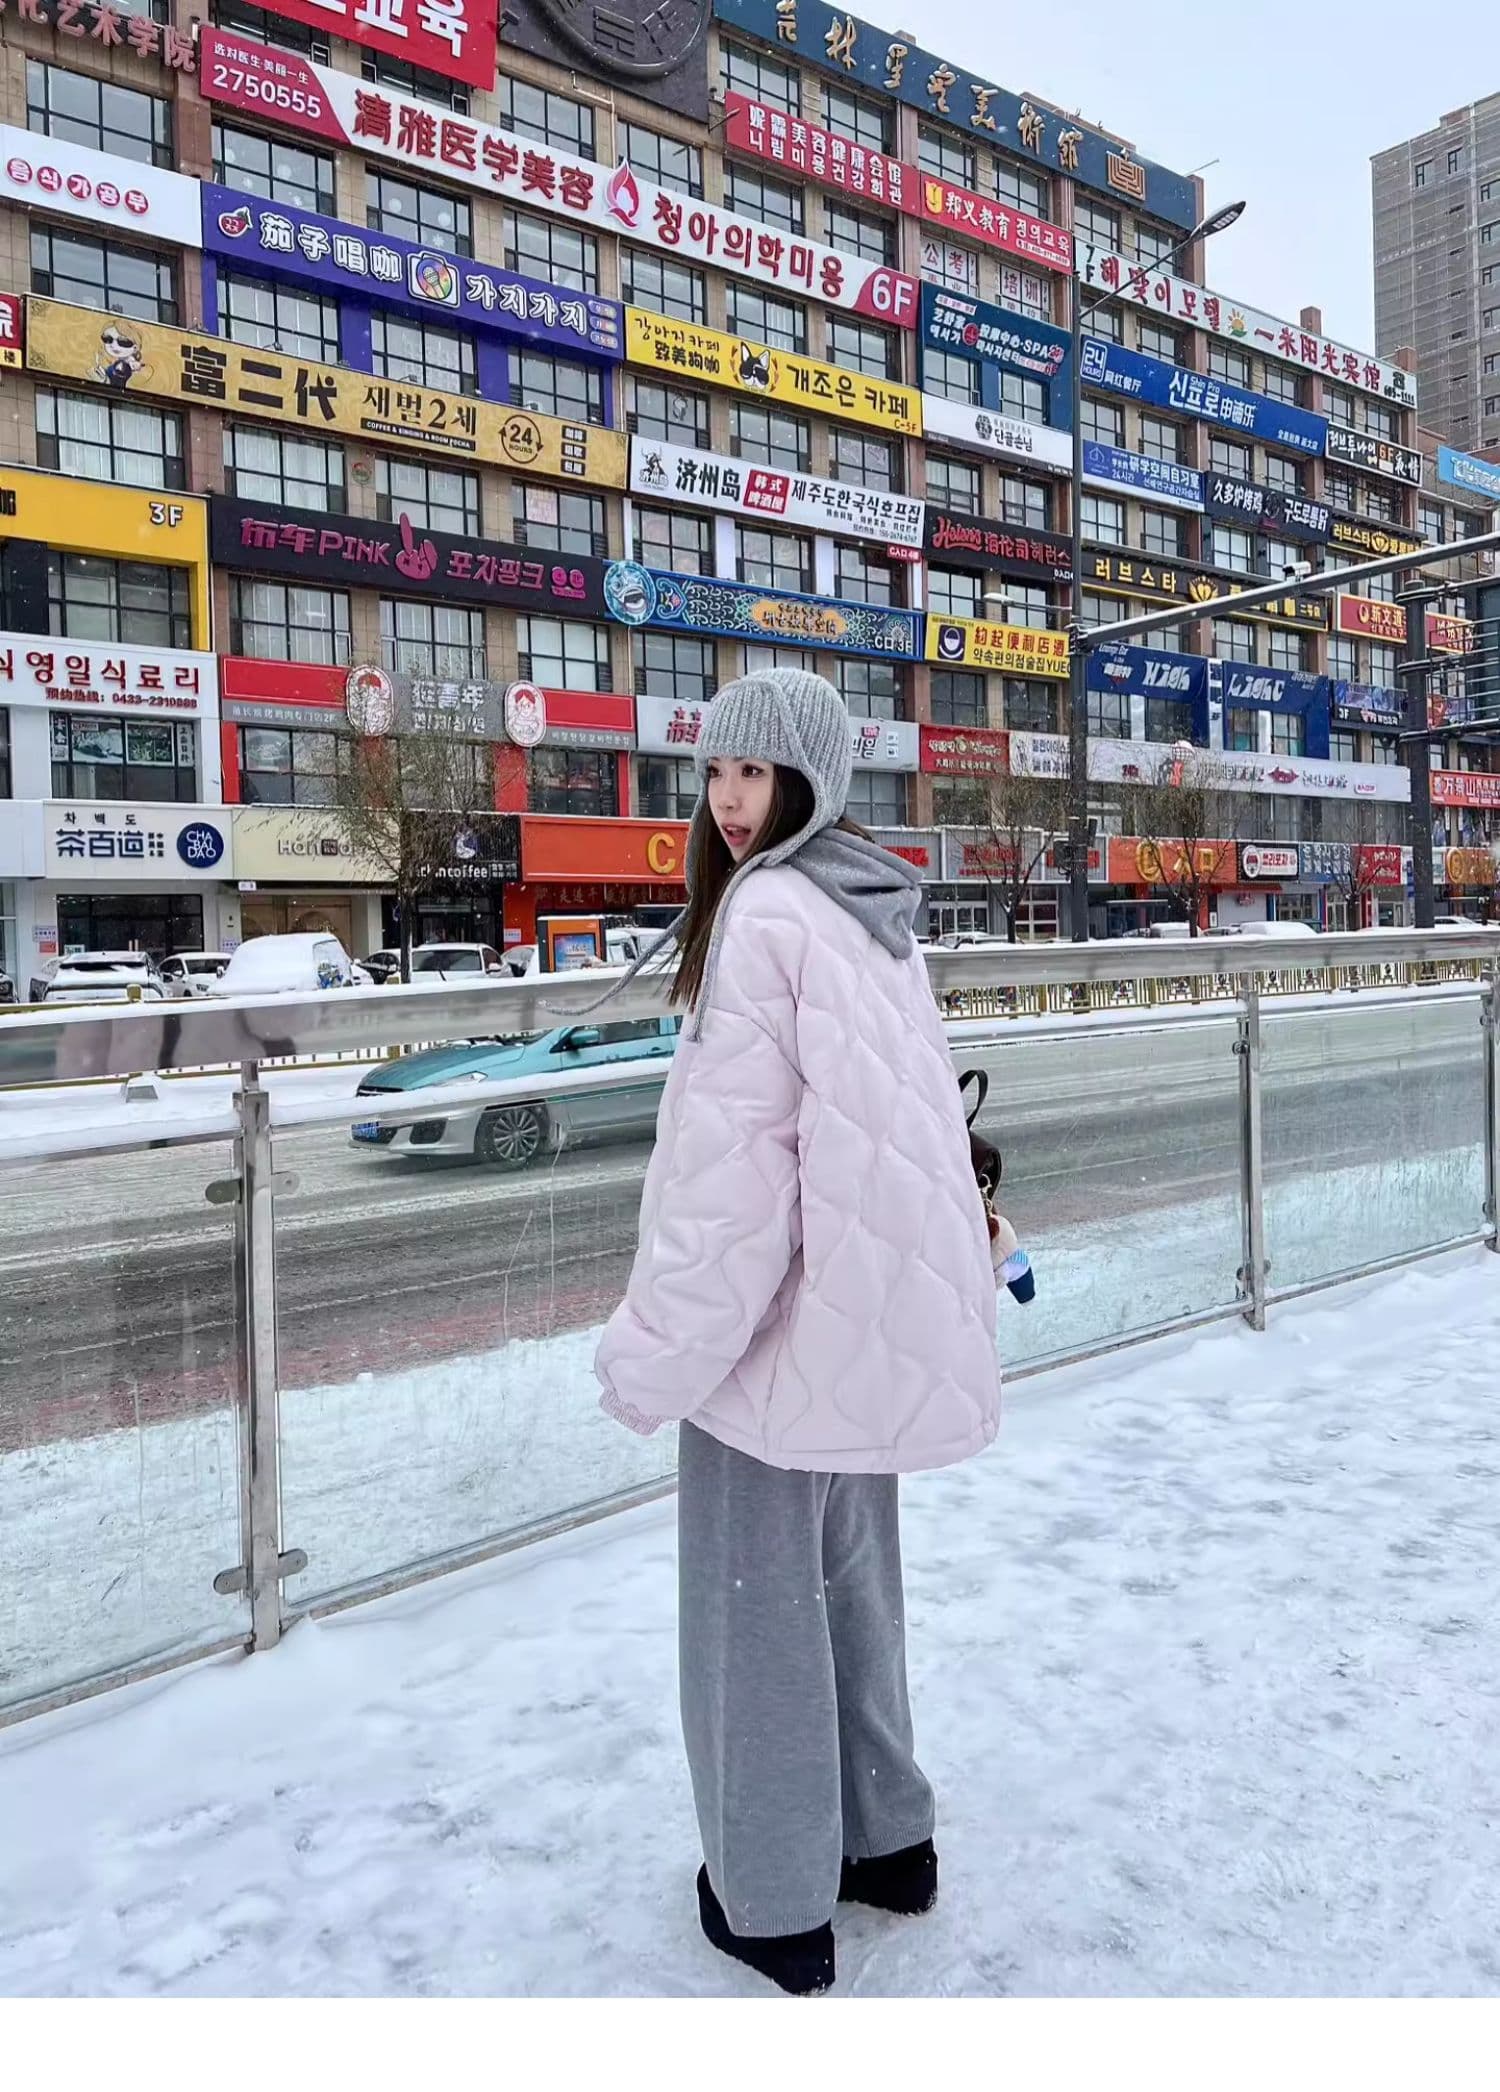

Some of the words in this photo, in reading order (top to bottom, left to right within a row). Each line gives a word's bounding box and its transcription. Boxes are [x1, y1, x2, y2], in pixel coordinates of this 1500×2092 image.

[213, 64, 322, 119] 2750555
[352, 87, 595, 212] 清雅医学美容
[259, 211, 402, 284] 茄子唱咖
[652, 192, 845, 299] 청아의학미용
[466, 274, 588, 336] 가지가지
[872, 272, 914, 316] 6F
[1084, 346, 1105, 369] 24
[1254, 327, 1382, 392] 一米阳光宾馆
[181, 343, 338, 421] 富二代
[1169, 371, 1219, 418] 신프로
[509, 423, 533, 446] 24
[675, 456, 741, 502] 济州岛
[149, 502, 184, 528] 3F
[446, 550, 545, 590] 포차핑크
[1095, 558, 1177, 594] 러브스타
[56, 828, 145, 858] 茶百道
[186, 830, 214, 842] CHA
